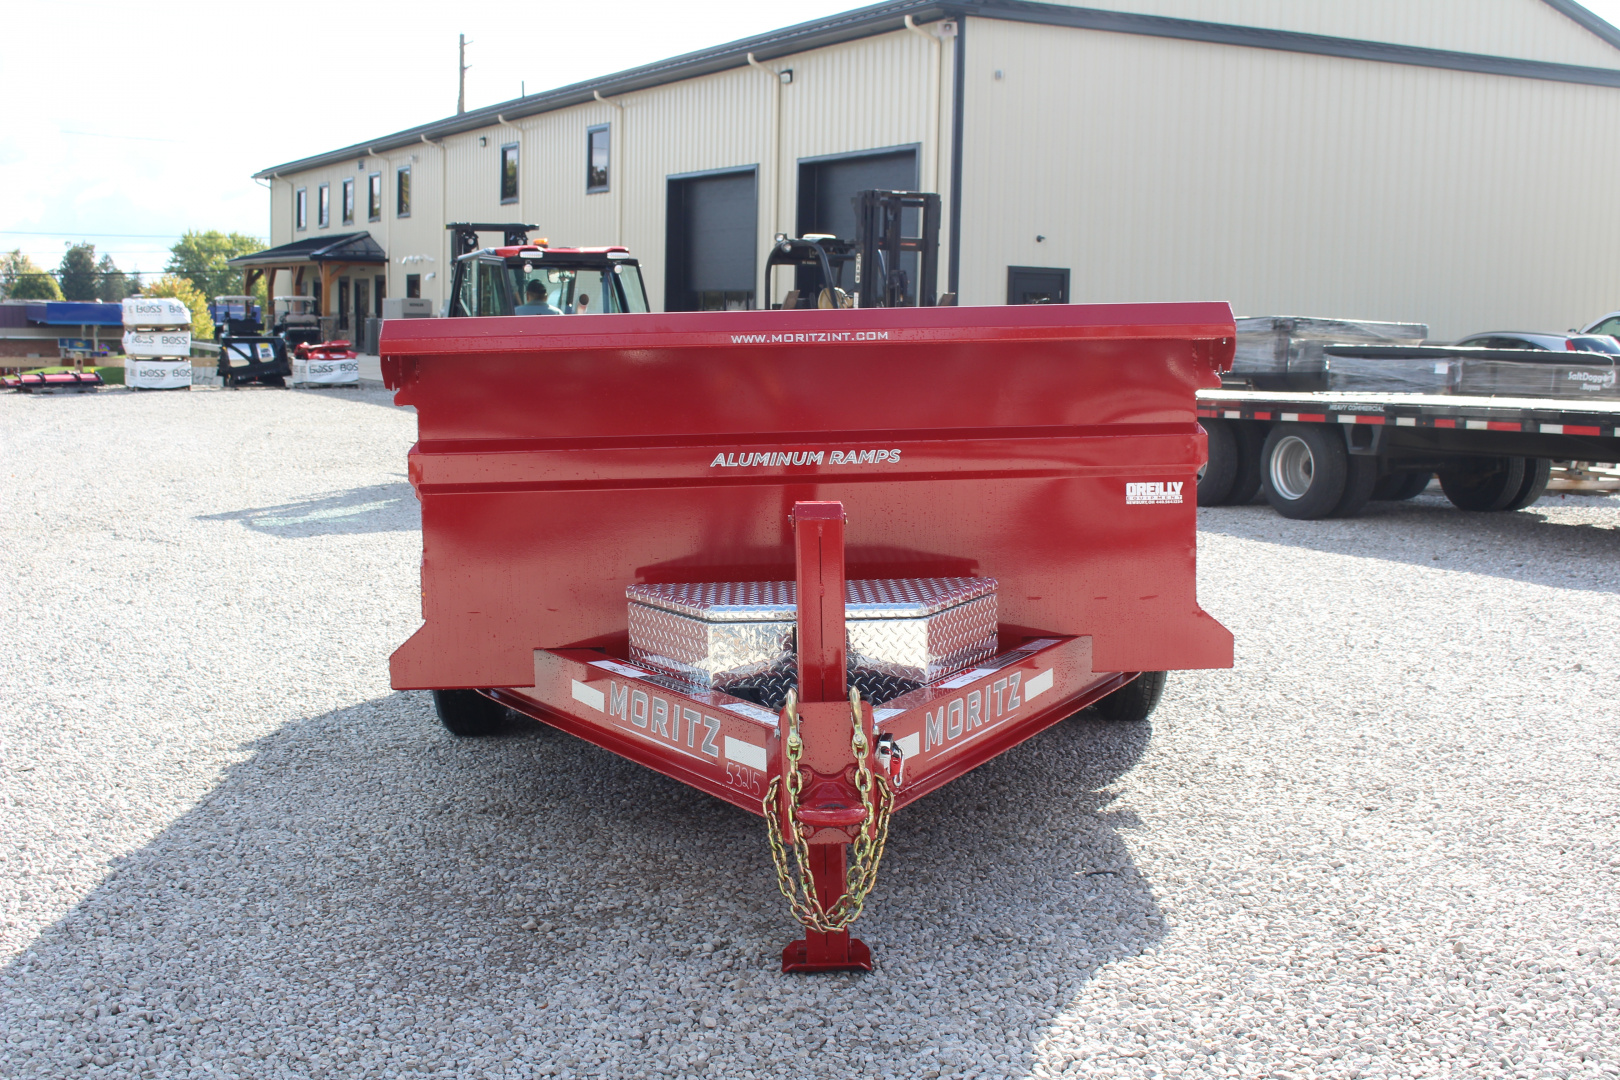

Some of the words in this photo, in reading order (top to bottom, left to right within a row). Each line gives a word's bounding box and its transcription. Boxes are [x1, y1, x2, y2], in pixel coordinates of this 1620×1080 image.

[137, 305, 162, 313] BOSS
[162, 336, 187, 344] BOSS
[731, 331, 889, 344] WWW.MORITZINT.COM
[139, 369, 166, 377] BOSS
[710, 451, 824, 467] ALUMINUM
[829, 449, 901, 464] RAMPS
[925, 671, 1021, 752] MORITZ
[610, 681, 721, 758] MORITZ
[726, 761, 761, 796] 53215
